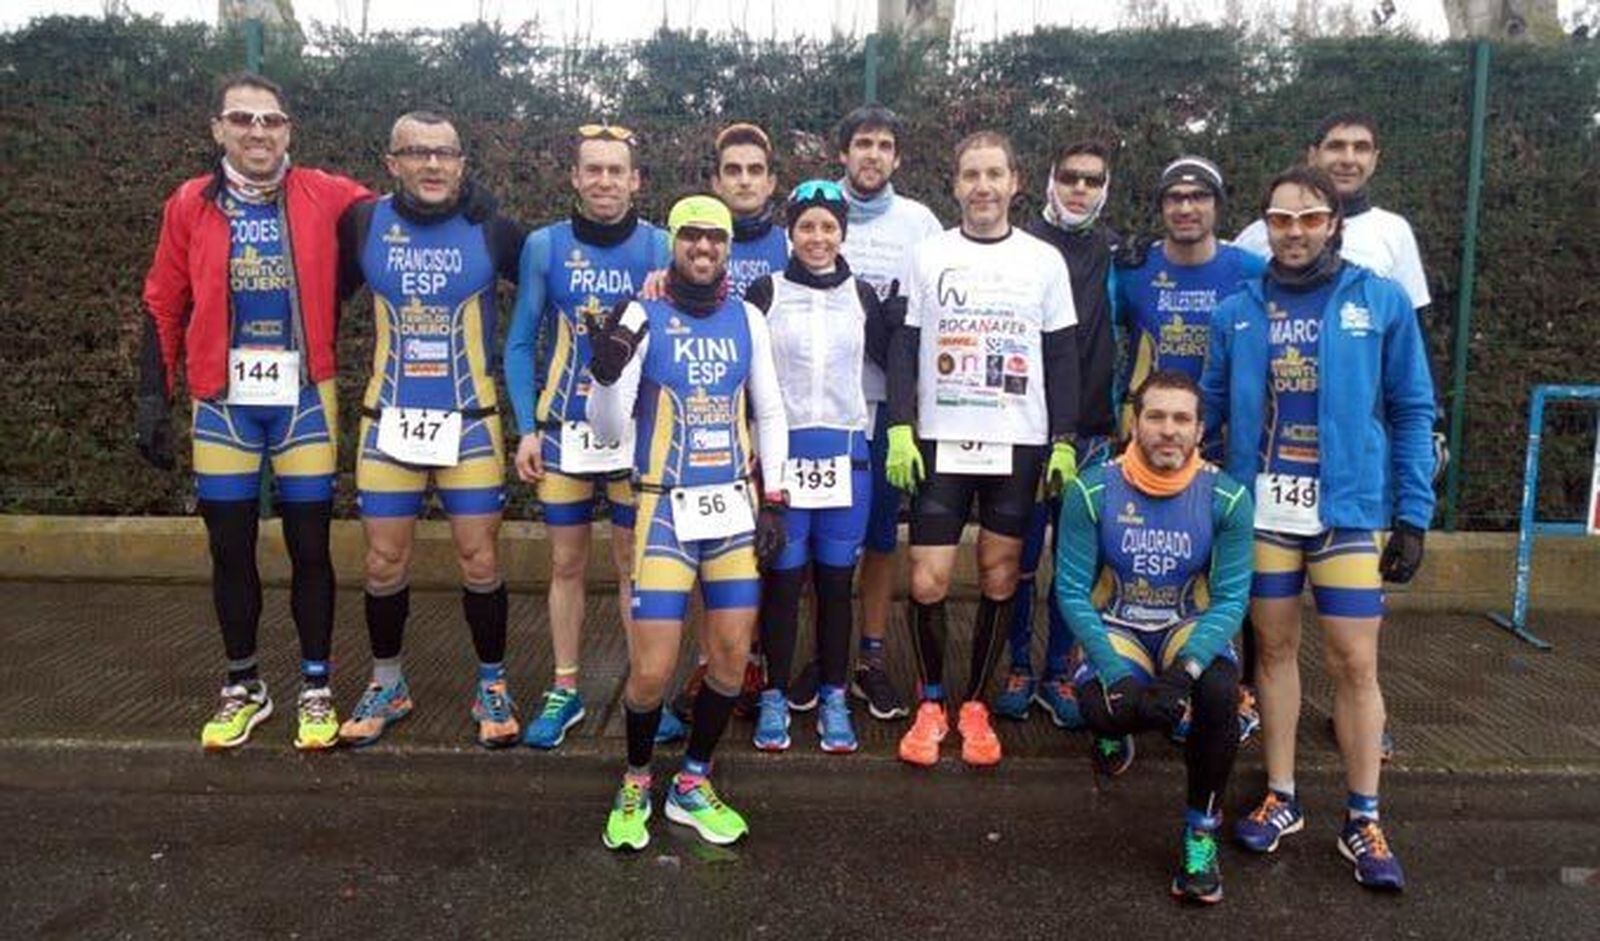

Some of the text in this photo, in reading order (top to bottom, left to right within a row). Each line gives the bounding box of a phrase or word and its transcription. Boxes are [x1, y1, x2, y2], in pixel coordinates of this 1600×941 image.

[387, 246, 462, 273] FRANCISCO
[402, 272, 447, 294] ESP
[570, 269, 633, 294] PRADA
[674, 337, 738, 362] KINI
[234, 361, 279, 381] 144
[688, 361, 727, 384] ESP
[400, 421, 442, 441] 147
[795, 468, 836, 490] 193
[698, 493, 727, 516] 56
[1271, 485, 1316, 509] 149
[1121, 527, 1191, 559] CUADRADO
[1133, 554, 1177, 576] ESP
